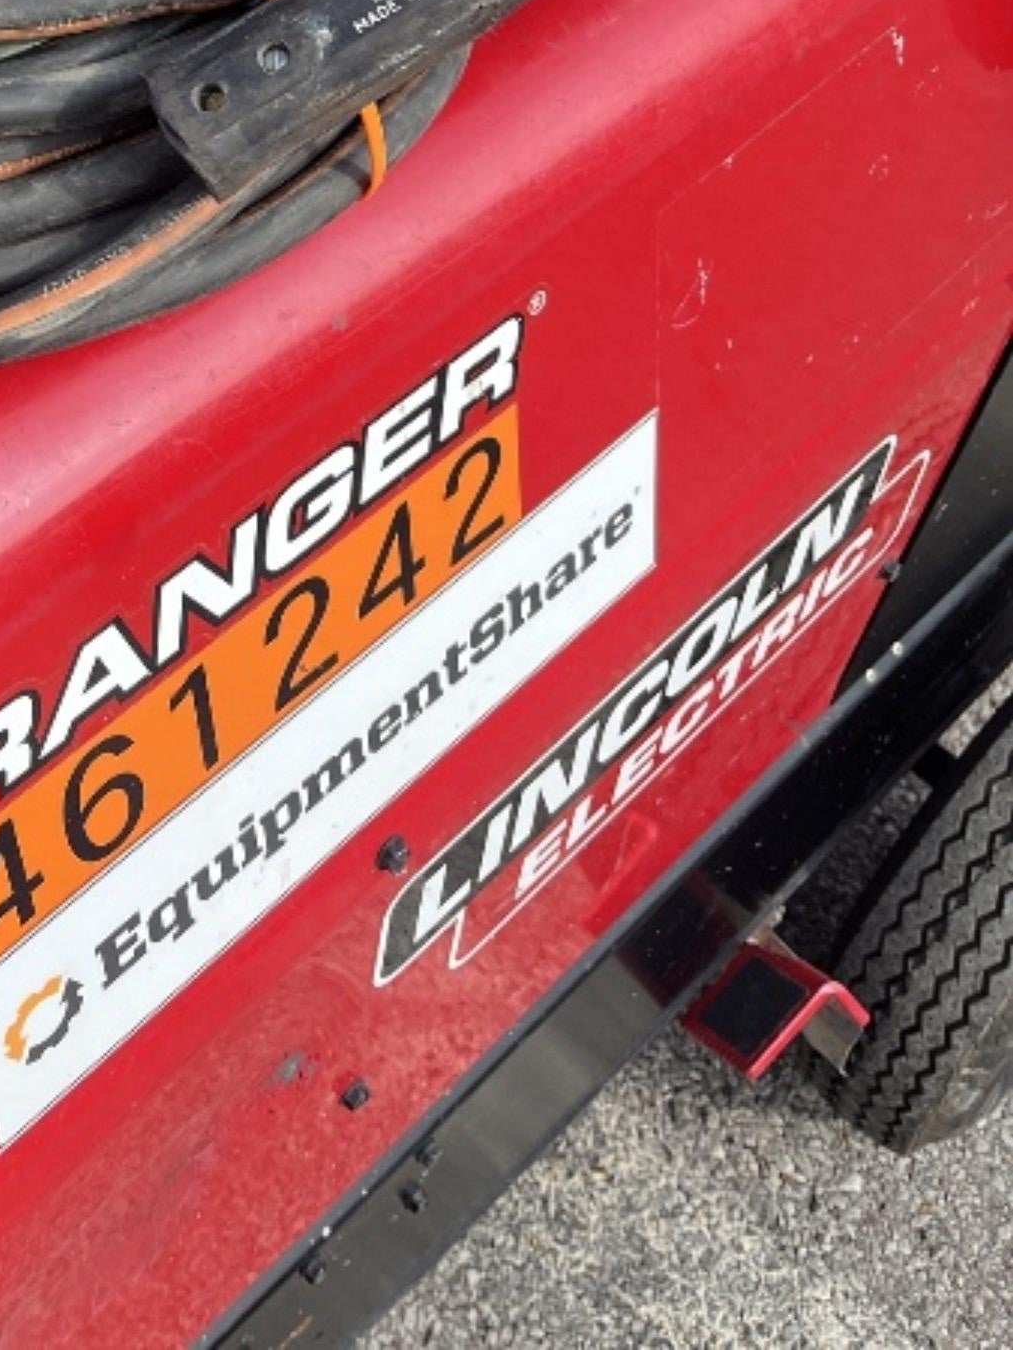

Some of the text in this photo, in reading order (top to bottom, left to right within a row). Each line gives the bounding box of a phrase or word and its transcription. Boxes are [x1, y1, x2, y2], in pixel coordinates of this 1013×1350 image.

[94, 499, 634, 990] EquipmentShare
[413, 474, 867, 941] LINCOLN
[516, 528, 873, 898] ELECTRIC
